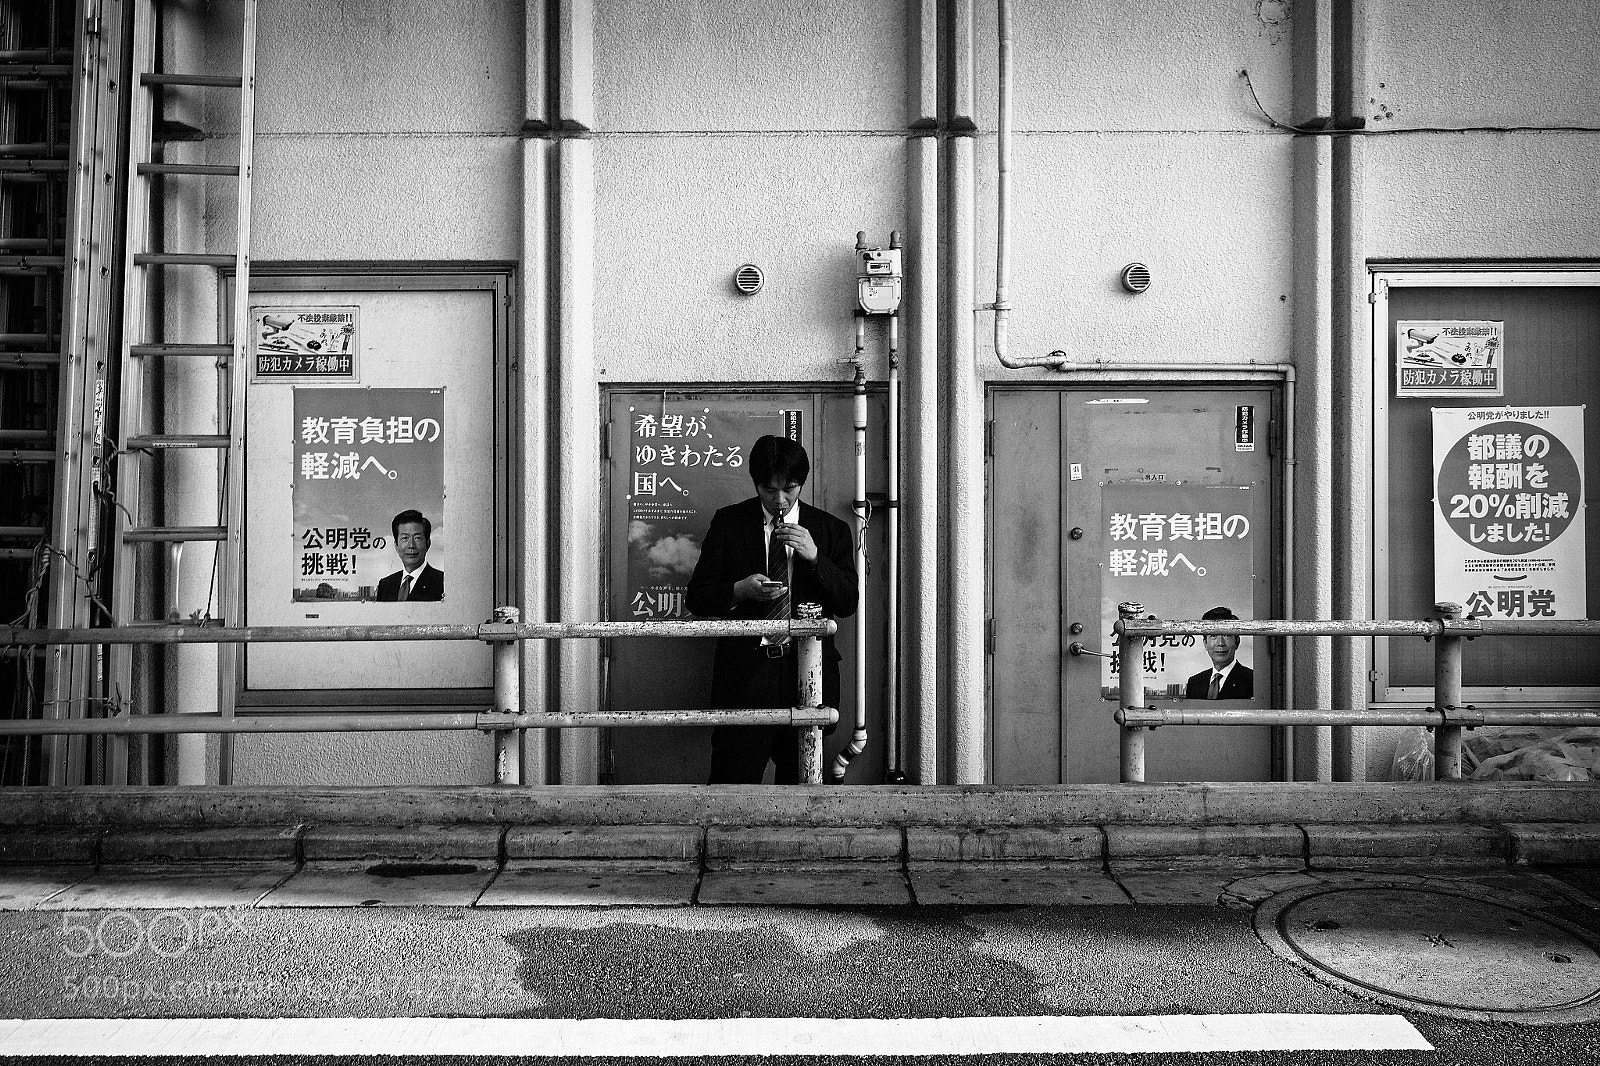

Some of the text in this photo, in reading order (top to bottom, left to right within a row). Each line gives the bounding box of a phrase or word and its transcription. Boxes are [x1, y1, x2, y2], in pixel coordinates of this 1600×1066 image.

[258, 356, 350, 372] 防犯カメラ稼働中
[1403, 369, 1495, 386] 防犯カメラ稼働中
[634, 413, 713, 439] 希望が、
[1467, 411, 1550, 420] 公明党がやりました!!
[301, 416, 441, 445] 教育負担の
[635, 444, 744, 468] ゆきわたる
[1467, 433, 1550, 461] 都議の
[301, 452, 398, 480] 軽減へ。
[1468, 462, 1549, 490] 報酬を
[634, 471, 690, 497] 国へ。
[1450, 492, 1569, 520] 20%削減
[301, 527, 387, 550] 公明党の
[1109, 512, 1250, 541] 教育負担の
[1469, 523, 1550, 543] しました!
[301, 553, 357, 576] 挑戦!
[1109, 549, 1207, 577] 軽減へ。
[631, 591, 692, 618] 公明
[1465, 589, 1557, 618] 公明党
